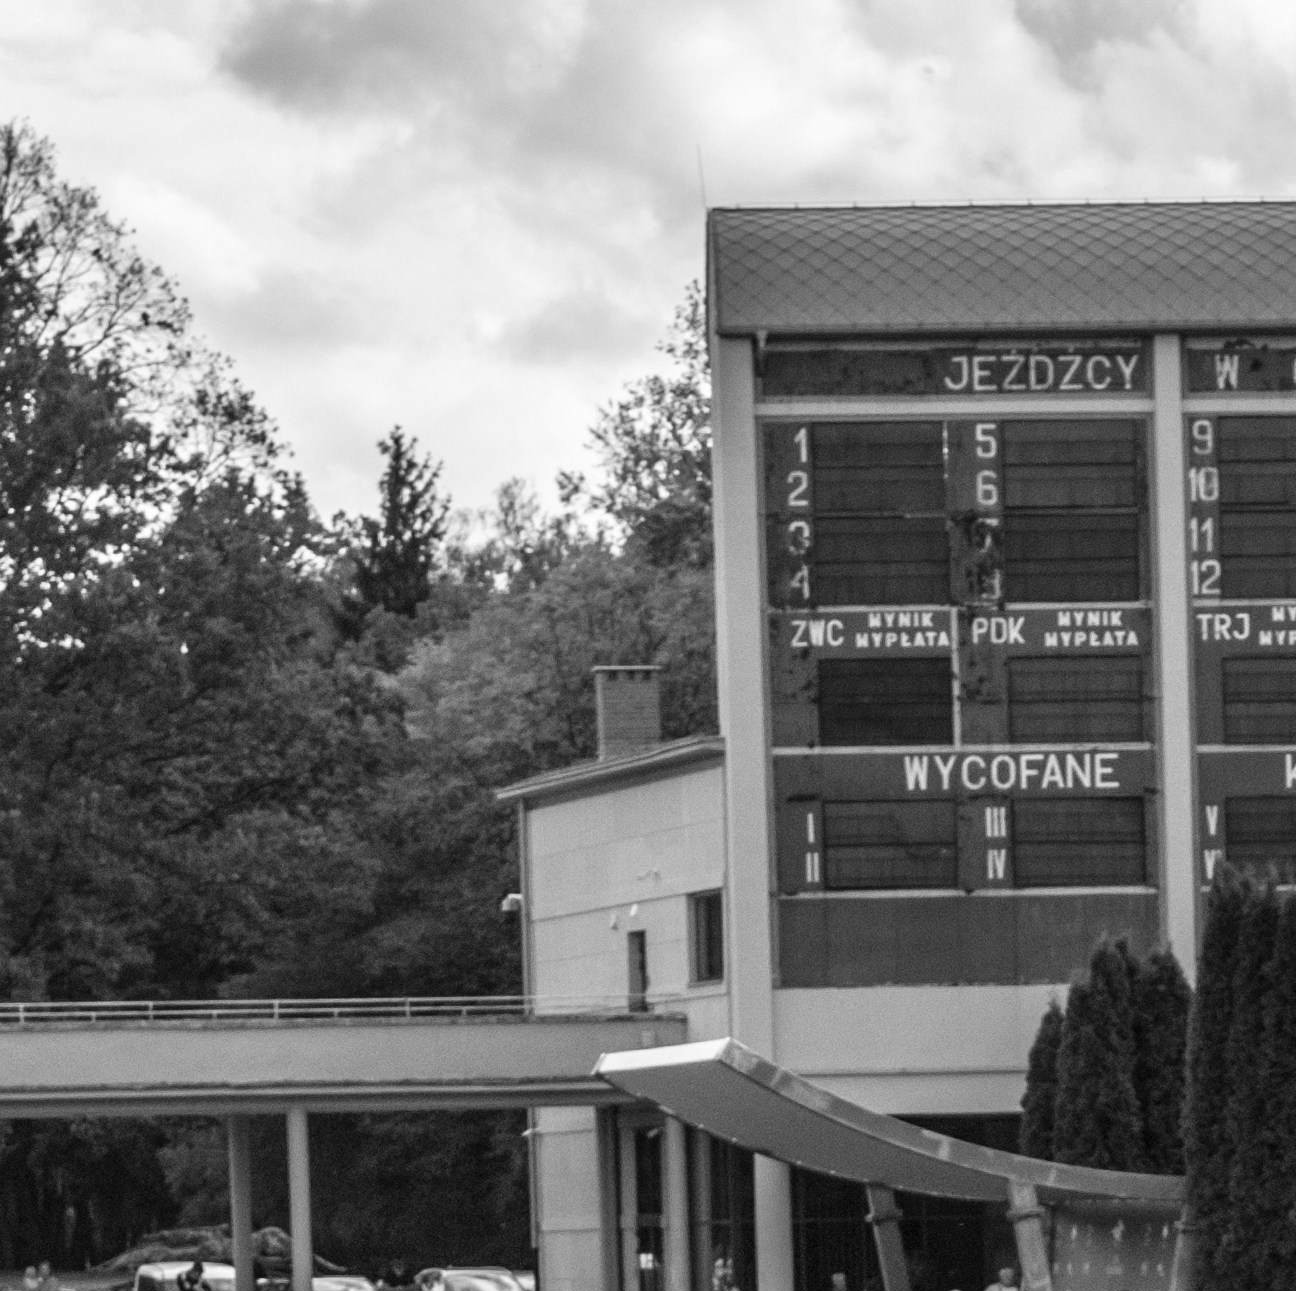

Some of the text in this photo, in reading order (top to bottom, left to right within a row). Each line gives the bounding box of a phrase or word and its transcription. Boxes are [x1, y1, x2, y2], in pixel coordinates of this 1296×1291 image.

[1215, 354, 1240, 390] W
[793, 427, 809, 464] 1
[975, 423, 998, 459] 5
[1192, 419, 1213, 454] 9
[787, 470, 809, 507] 2
[975, 469, 999, 506] 6
[1188, 466, 1219, 501] 10
[788, 520, 811, 556] 3
[1189, 516, 1215, 552] 11
[790, 564, 811, 600] 4
[1190, 559, 1221, 595] 12
[790, 619, 844, 647] ZWC
[868, 612, 934, 628] WYNIK
[972, 616, 1026, 645] PDK
[1057, 611, 1123, 627] WYNIK
[1196, 613, 1250, 640] TRJ
[855, 631, 950, 648] WYPŁATA
[1044, 629, 1139, 647] WYPŁATA
[904, 752, 1120, 791] WYCOFANE
[806, 812, 815, 843] I
[984, 806, 1006, 838] III
[1205, 805, 1218, 836] V
[805, 851, 820, 883] II
[986, 848, 1005, 880] IV
